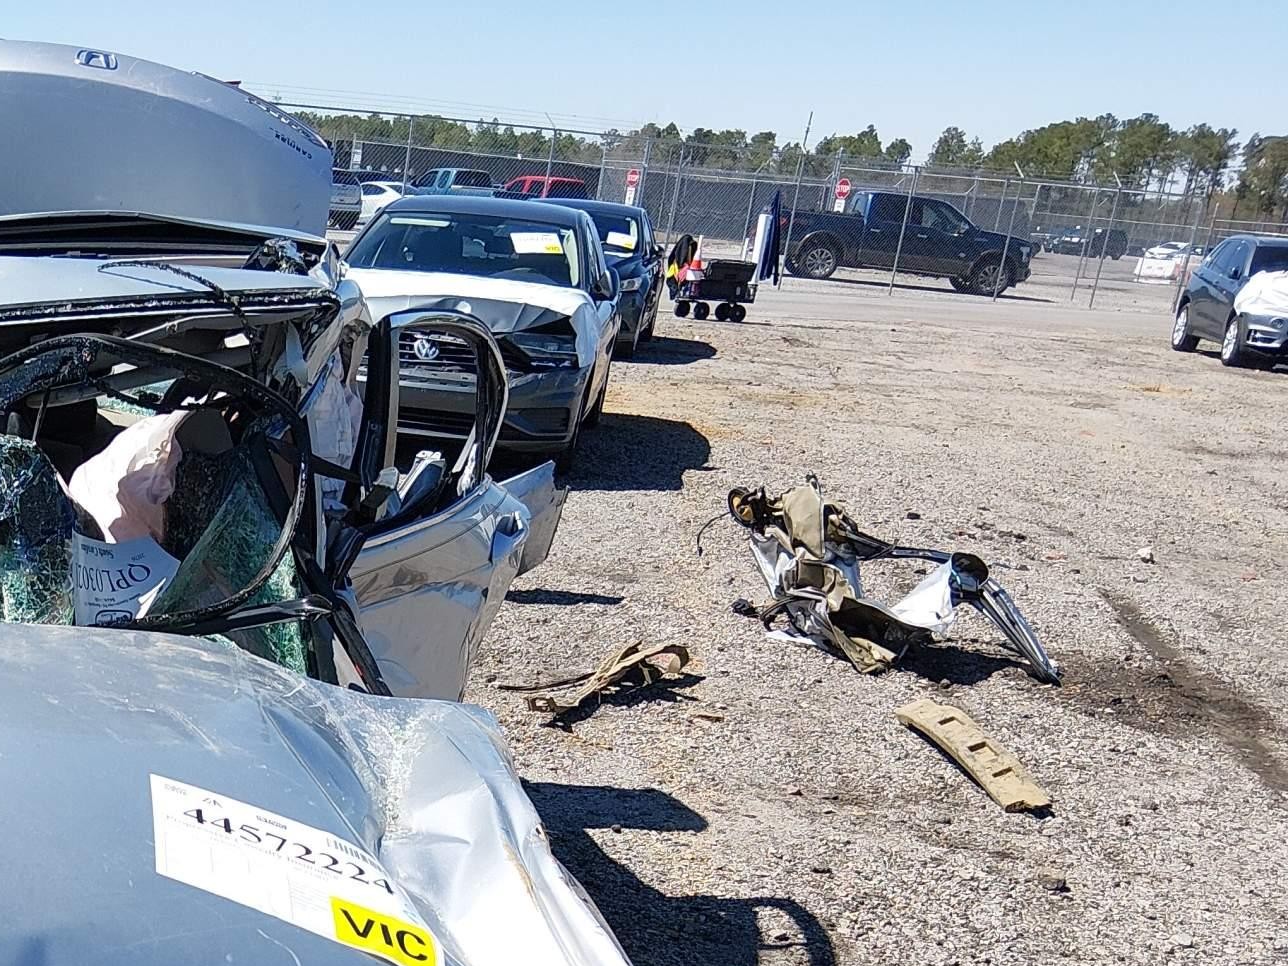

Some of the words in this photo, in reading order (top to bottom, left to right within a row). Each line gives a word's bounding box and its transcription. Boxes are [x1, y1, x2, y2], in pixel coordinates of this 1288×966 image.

[836, 185, 850, 193] STOP
[183, 808, 395, 895] 44572224
[339, 908, 429, 961] VIC
